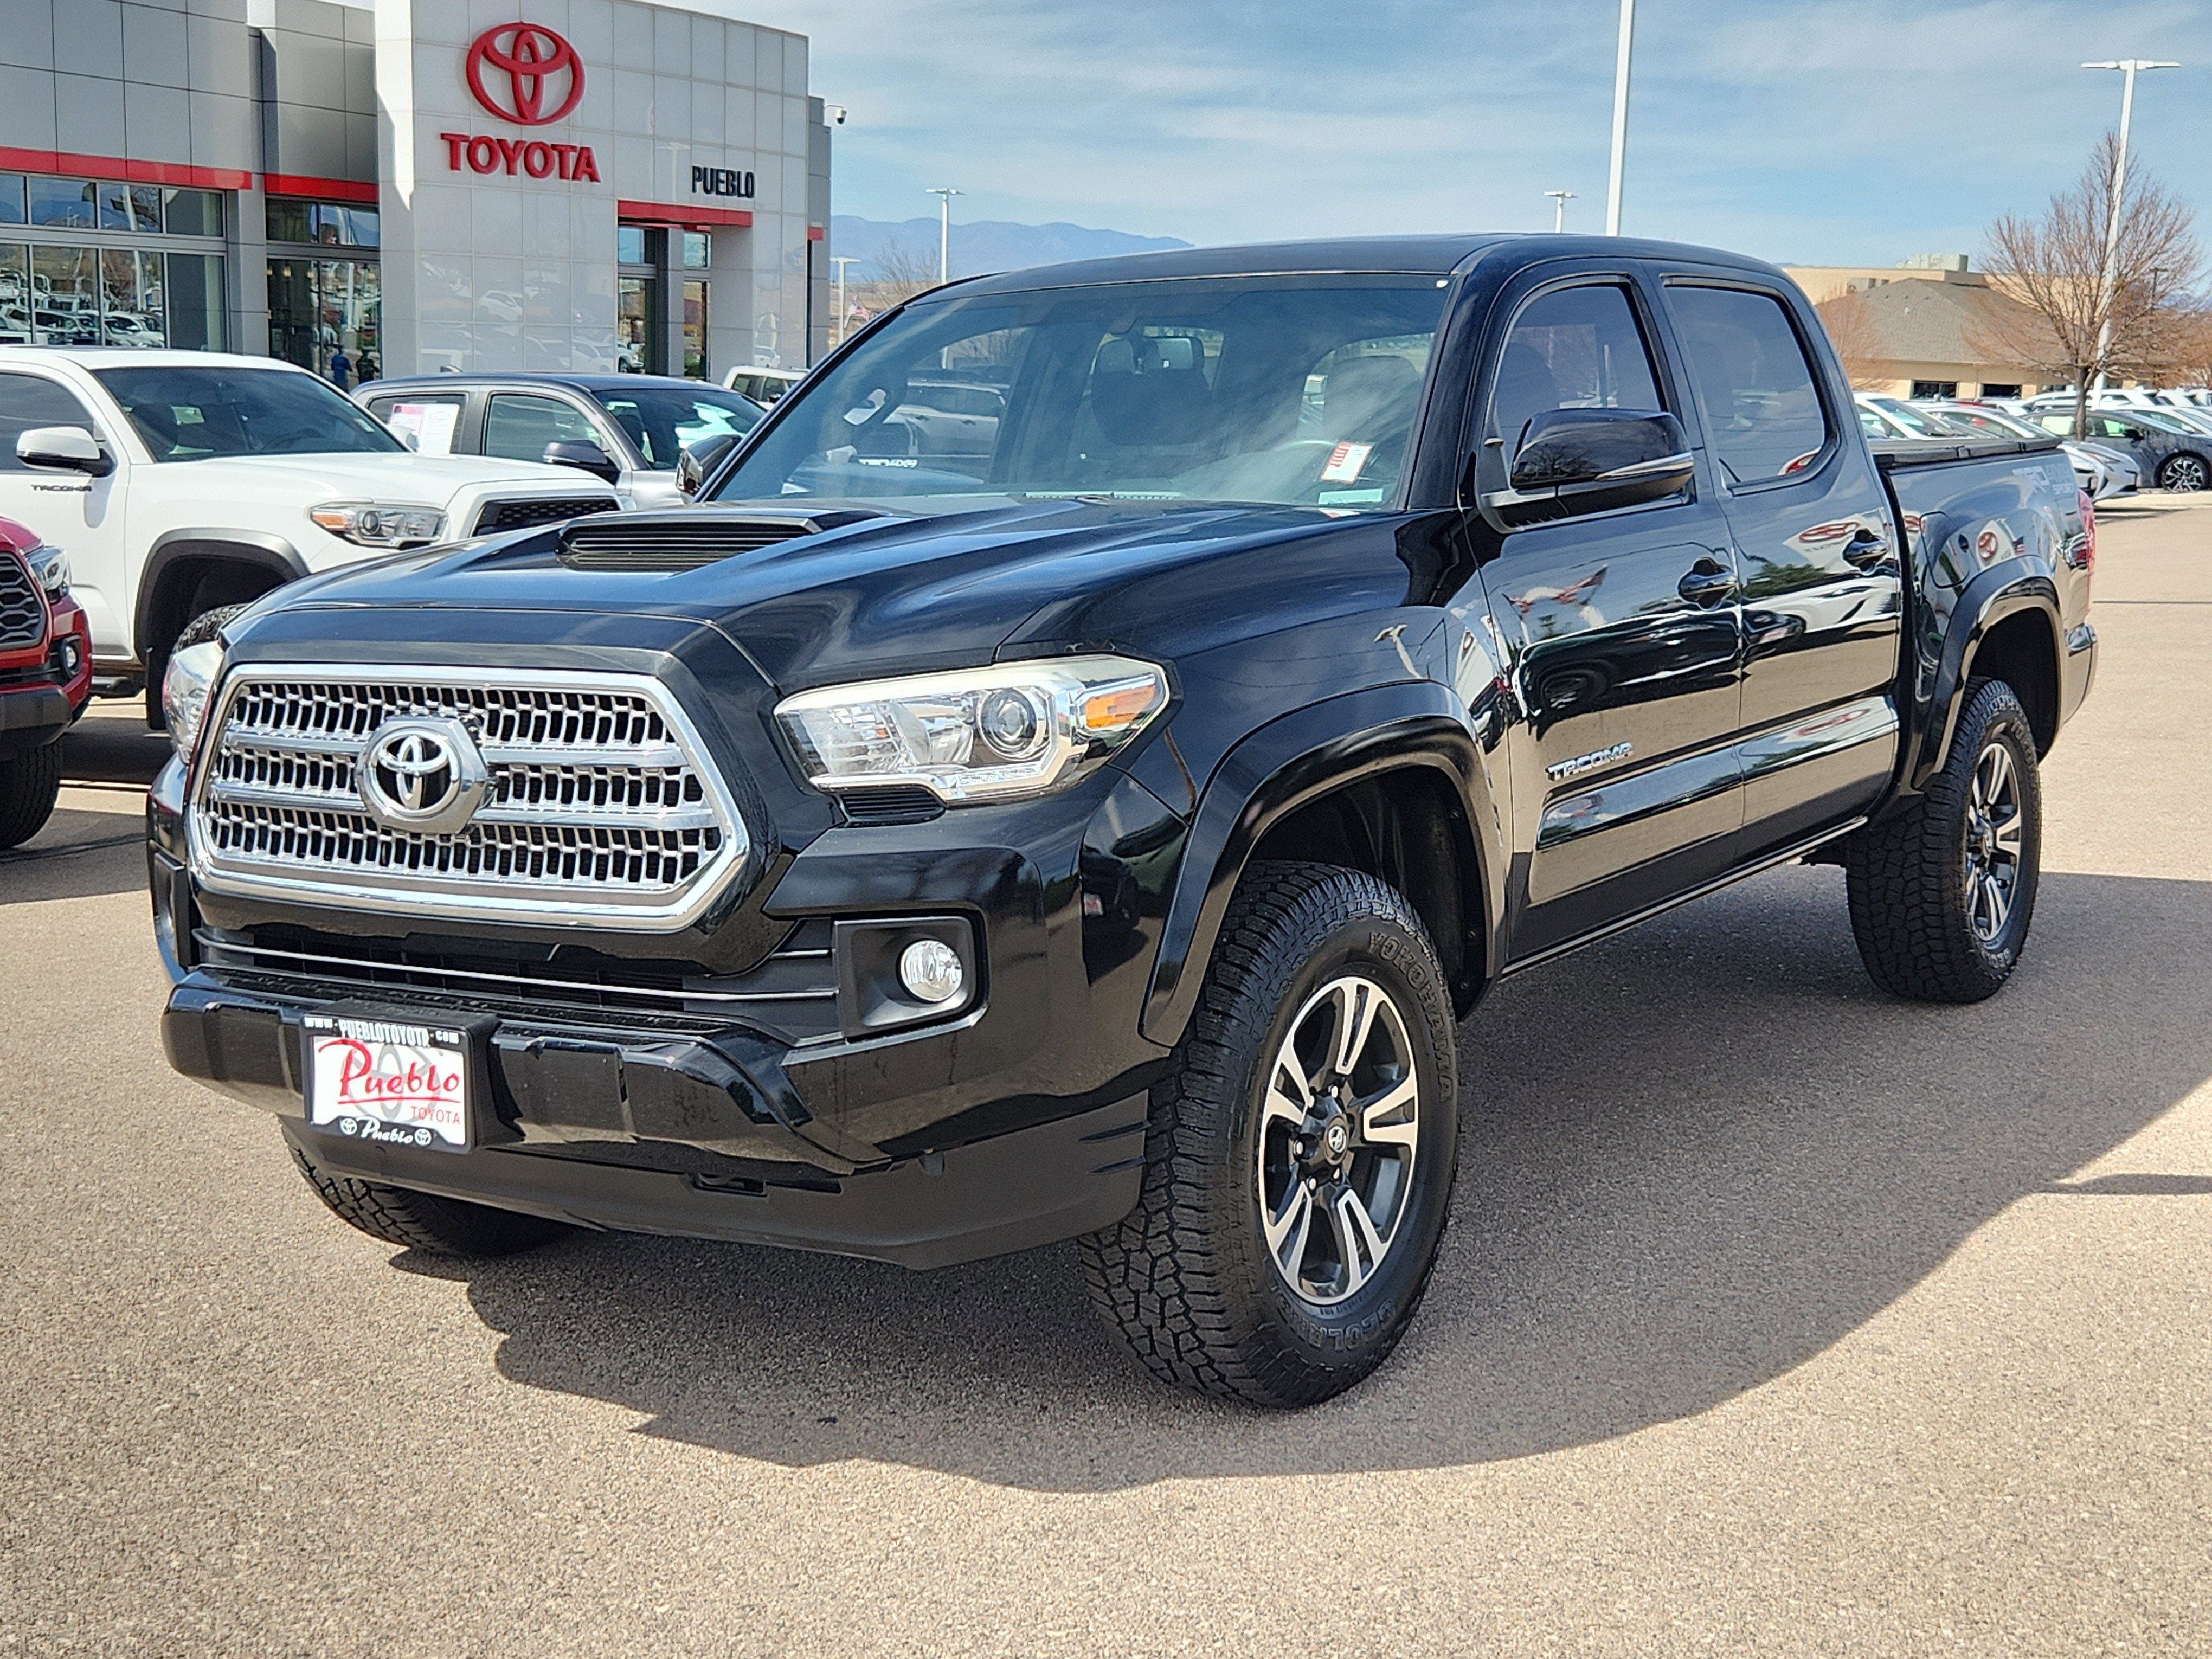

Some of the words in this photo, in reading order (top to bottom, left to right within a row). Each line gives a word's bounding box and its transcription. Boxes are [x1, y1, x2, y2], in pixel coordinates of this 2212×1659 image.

[440, 132, 601, 183] TOYOTA
[691, 166, 756, 198] PUEBLO
[1545, 741, 1634, 781] TACOMA
[1359, 932, 1454, 1103] YOKOHAMA
[318, 1038, 460, 1097] Pueblo
[356, 1115, 414, 1144] Pueblo
[411, 1105, 461, 1126] TOYOTA
